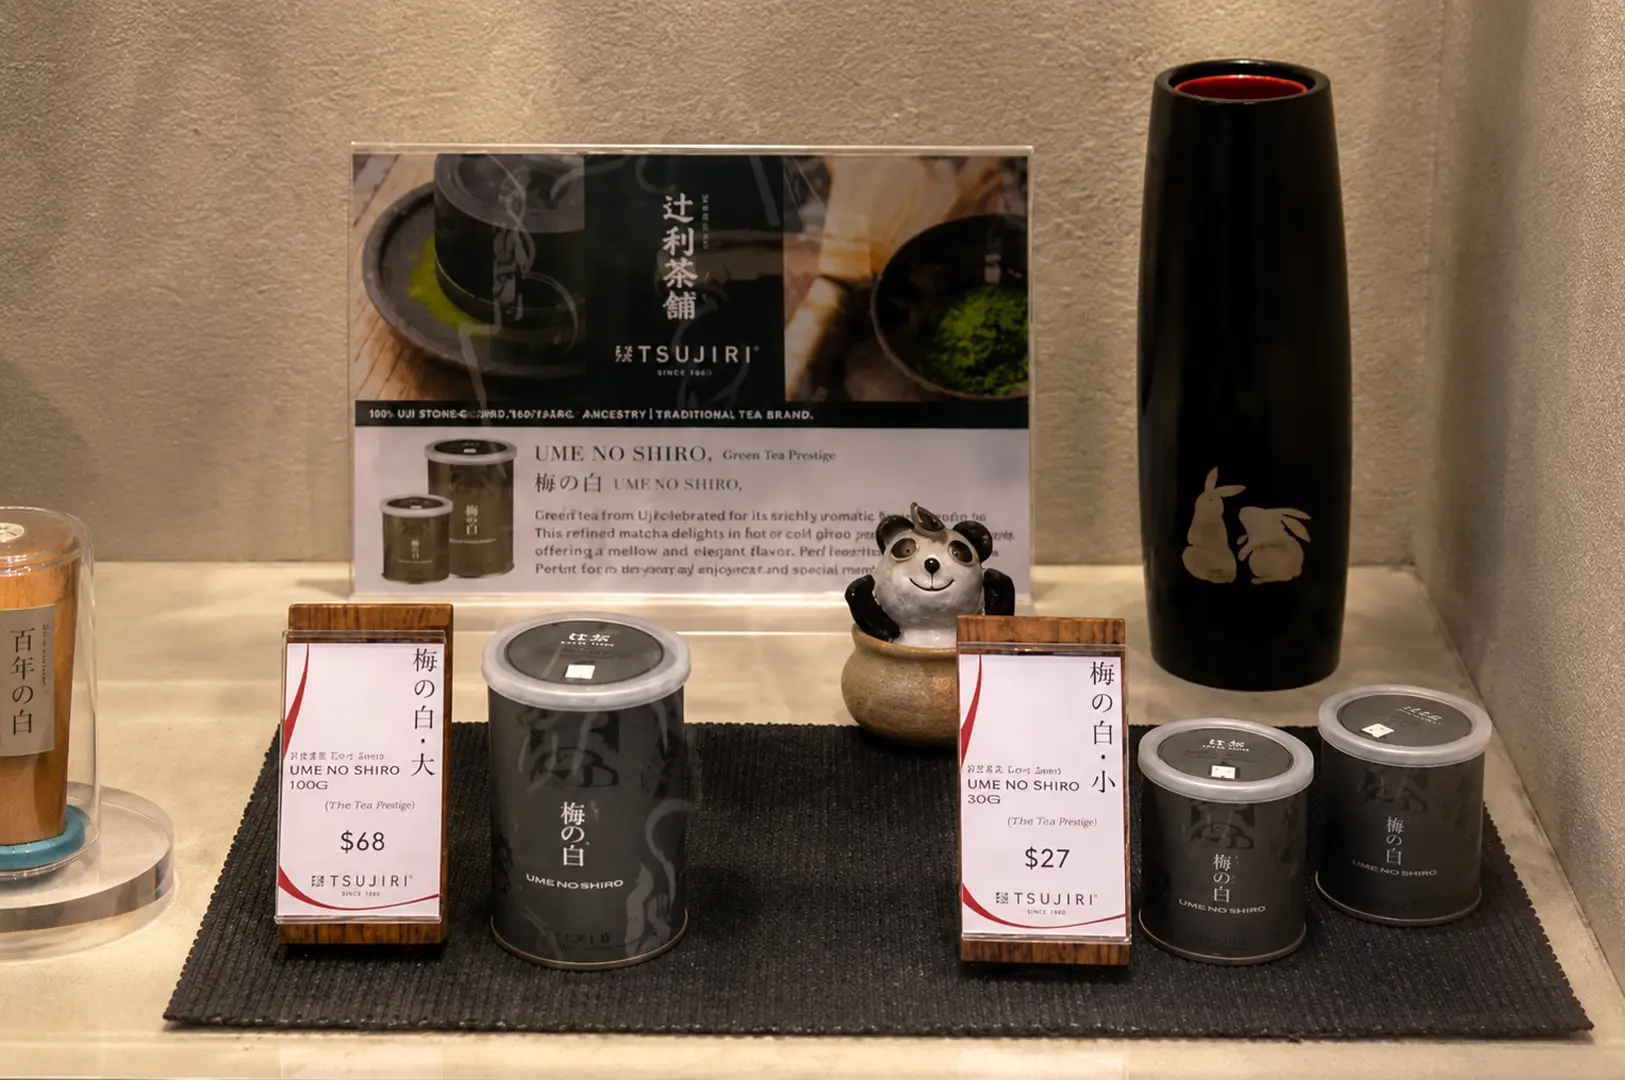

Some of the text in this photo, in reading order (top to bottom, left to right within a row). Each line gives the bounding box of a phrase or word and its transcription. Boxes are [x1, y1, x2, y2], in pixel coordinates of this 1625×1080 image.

[638, 345, 751, 363] TSUJIRI
[398, 409, 415, 420] UJI
[582, 409, 646, 420] ANCESTRY
[656, 409, 735, 420] TRADITIONAL
[739, 410, 762, 420] TEA
[766, 410, 814, 420] BRAND.
[535, 445, 836, 464] UME NO SHIRO, Green Tea Prestige
[534, 472, 602, 493] 梅の白
[655, 478, 679, 491] NO
[684, 478, 744, 493] SHIRO,
[601, 509, 634, 521] from
[729, 509, 748, 521] for
[752, 509, 768, 521] its
[535, 528, 563, 539] This
[566, 527, 616, 539] refined
[618, 528, 669, 539] matcha
[671, 528, 725, 542] delights
[728, 528, 741, 539] in
[769, 529, 782, 539] or
[608, 546, 658, 557] mellow
[662, 547, 688, 557] and
[10, 627, 35, 736] 百年の白
[411, 648, 438, 777] 梅の白・大
[1090, 661, 1116, 794] 梅の白・小
[289, 765, 400, 776] UME NO SHIRO
[290, 781, 328, 790] 100G
[967, 779, 1080, 792] UME NO SHIRO
[325, 800, 415, 812] (The Tea Prestige)
[967, 794, 1001, 804] 30G
[1007, 816, 1097, 828] (The Tea Prestige)
[560, 801, 586, 867] 梅の白
[1386, 816, 1404, 866] 梅の白
[340, 830, 385, 854] $68
[1025, 846, 1070, 870] $27
[330, 875, 408, 887] TSUJIRI
[1212, 853, 1232, 904] 梅の白
[1014, 892, 1093, 906] TSUJIRI
